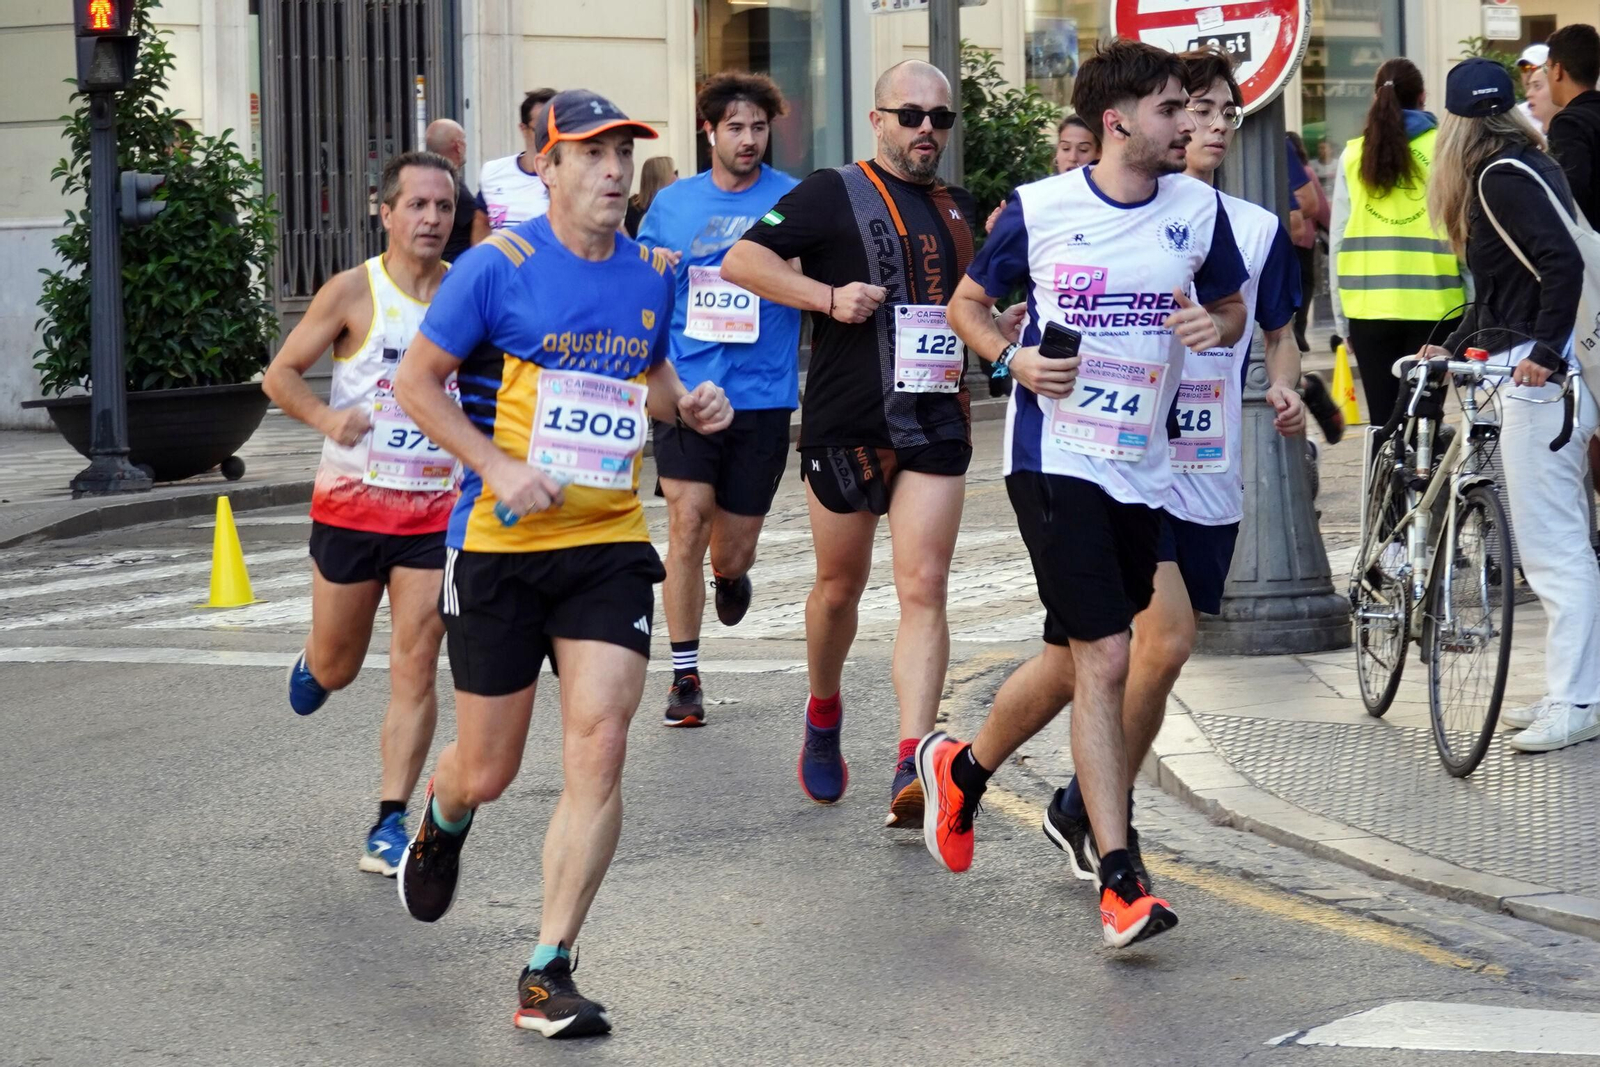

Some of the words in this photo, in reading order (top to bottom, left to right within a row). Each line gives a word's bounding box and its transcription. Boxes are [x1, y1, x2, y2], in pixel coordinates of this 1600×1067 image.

[694, 291, 750, 309] 1030
[542, 328, 649, 360] agustinos
[916, 334, 957, 355] 122
[1580, 337, 1596, 351] la
[1086, 359, 1146, 376] CARRERA
[1078, 385, 1141, 416] 714
[544, 406, 636, 440] 1308
